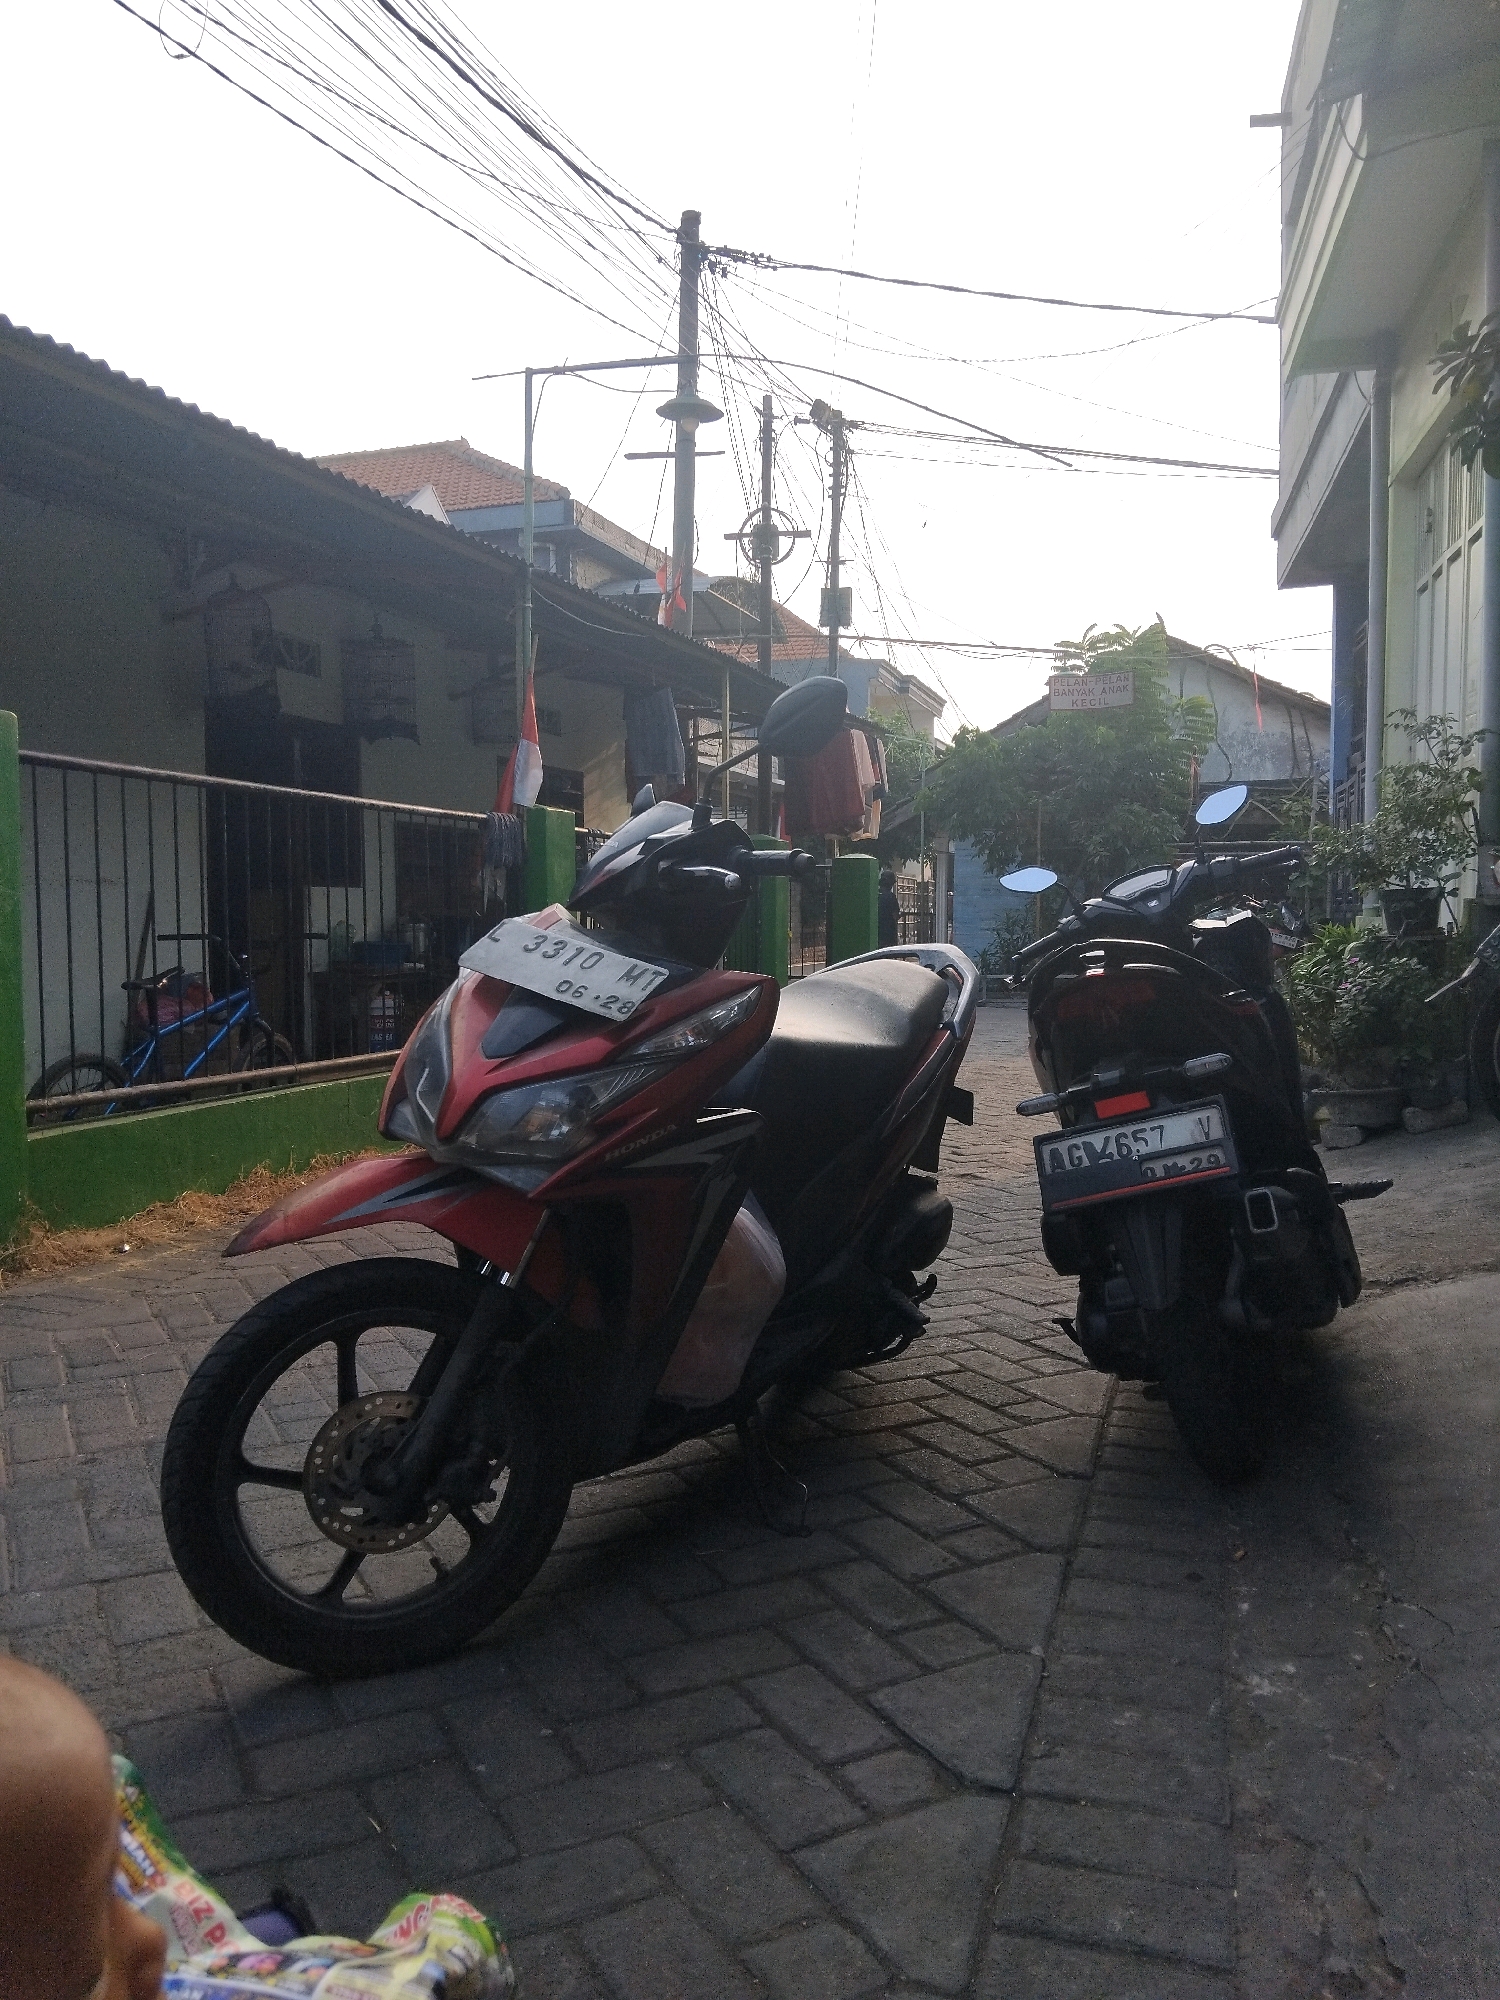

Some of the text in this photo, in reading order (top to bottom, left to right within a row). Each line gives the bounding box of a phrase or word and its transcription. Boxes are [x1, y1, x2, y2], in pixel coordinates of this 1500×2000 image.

[1053, 674, 1130, 687] PELAN-PELAN
[1053, 684, 1130, 697] BANYAK ANAK
[1071, 698, 1110, 708] KECIL
[487, 921, 666, 992] L 3310 MT
[1197, 1114, 1211, 1141] V
[604, 1123, 678, 1162] HONDA
